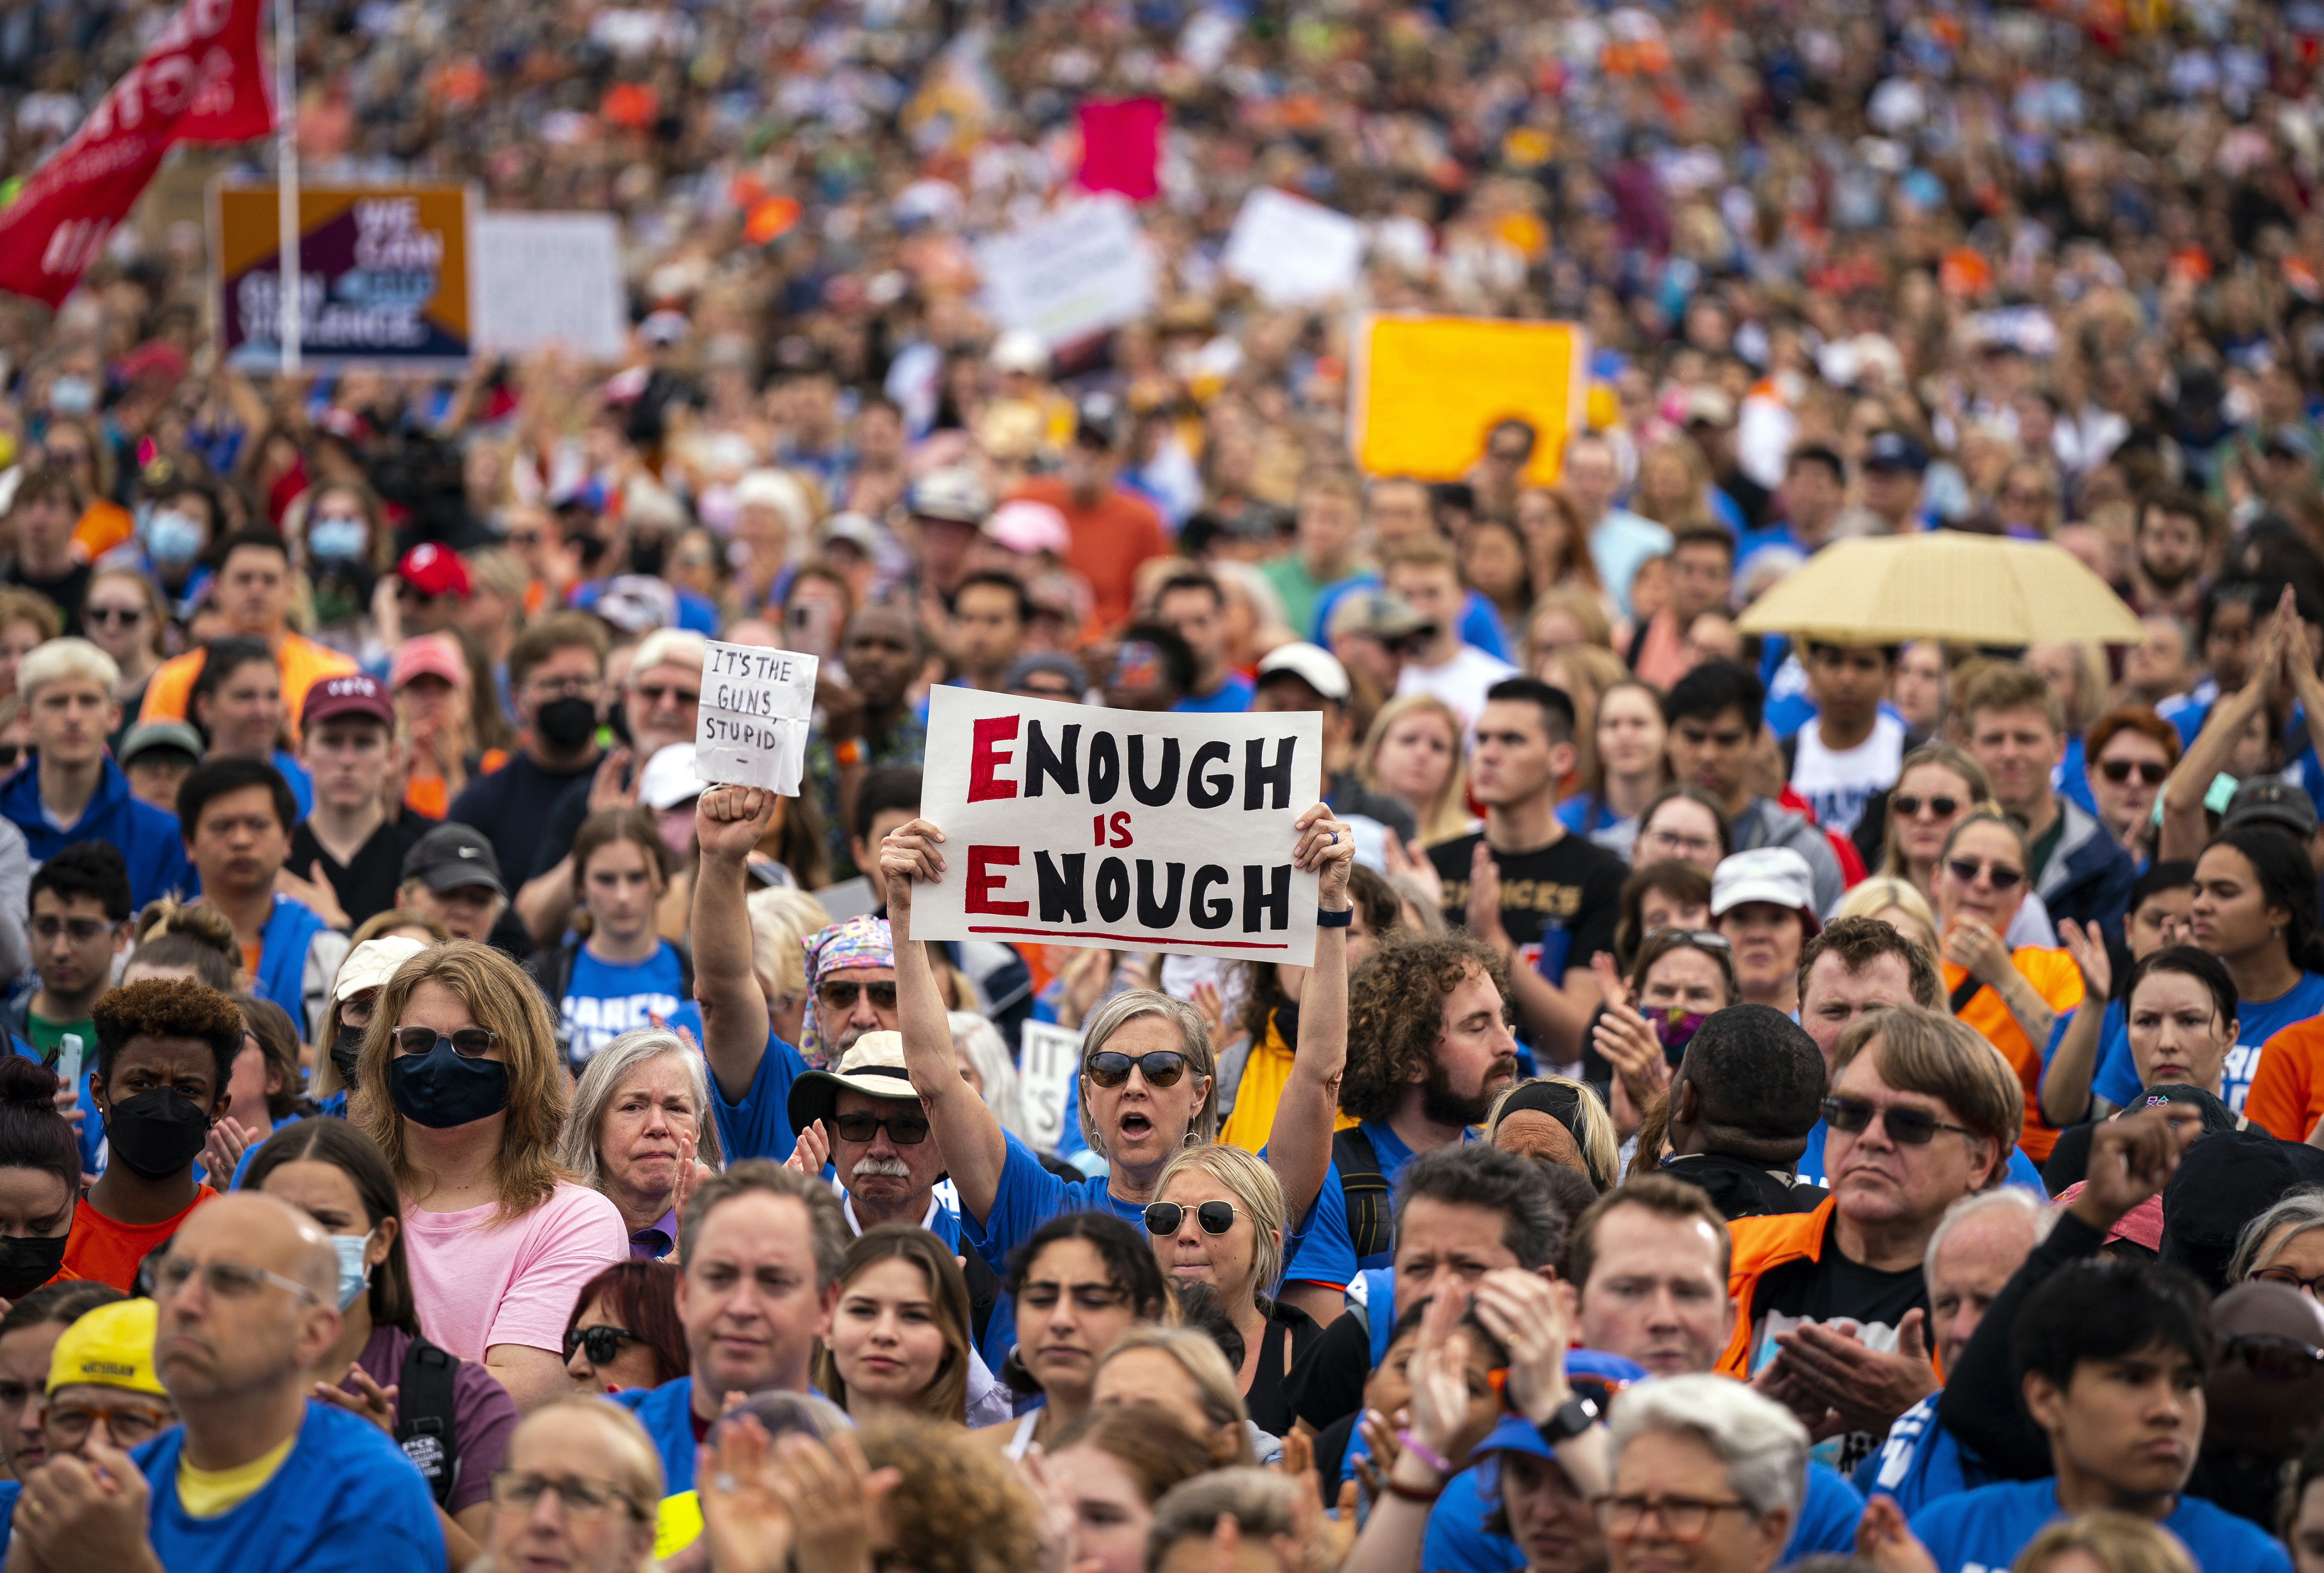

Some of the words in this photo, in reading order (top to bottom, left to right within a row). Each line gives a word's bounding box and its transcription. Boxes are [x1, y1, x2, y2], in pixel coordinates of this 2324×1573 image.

[712, 649, 750, 677] IT'S
[756, 657, 792, 682] THE
[718, 684, 776, 724] GUNS,
[706, 718, 775, 749] STUPID
[967, 714, 1297, 811] ENOUGH
[1094, 811, 1133, 849] IS
[964, 845, 1292, 933] ENOUGH
